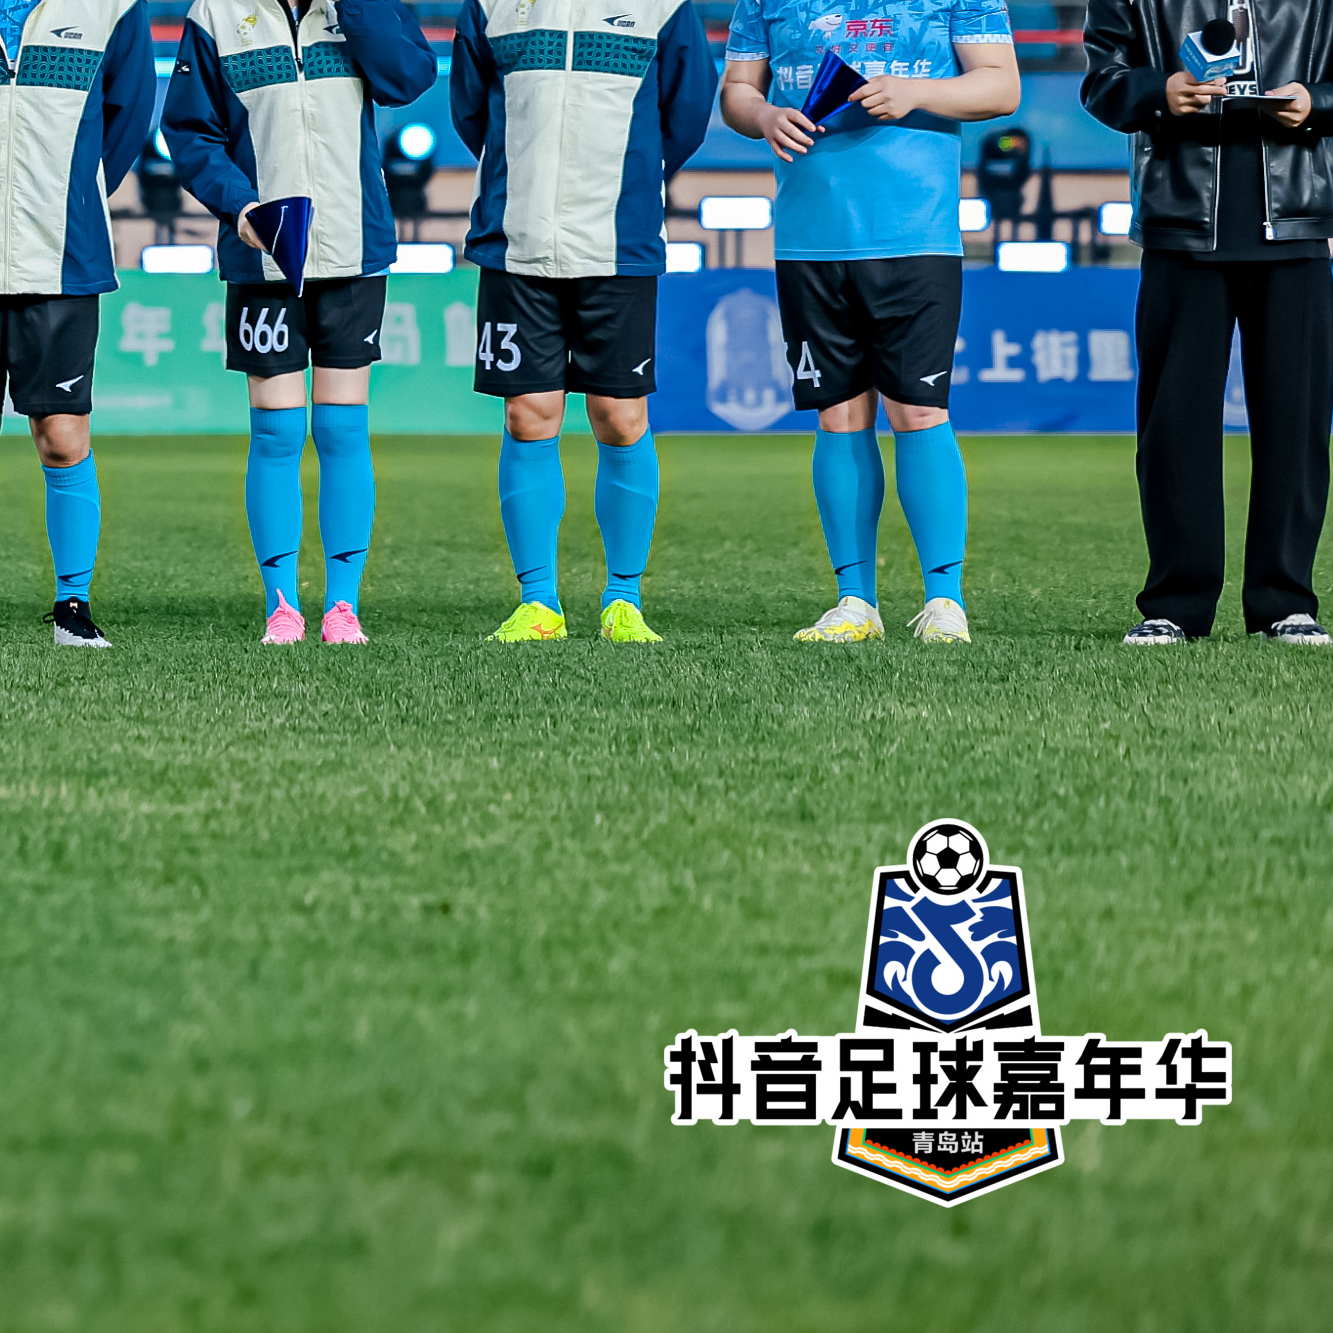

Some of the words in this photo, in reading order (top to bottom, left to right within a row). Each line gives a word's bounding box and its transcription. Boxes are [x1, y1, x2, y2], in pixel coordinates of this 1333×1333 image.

[845, 18, 893, 38] 京东
[776, 58, 933, 91] 抖音嘉年华
[239, 307, 289, 354] 666
[478, 321, 522, 372] 43
